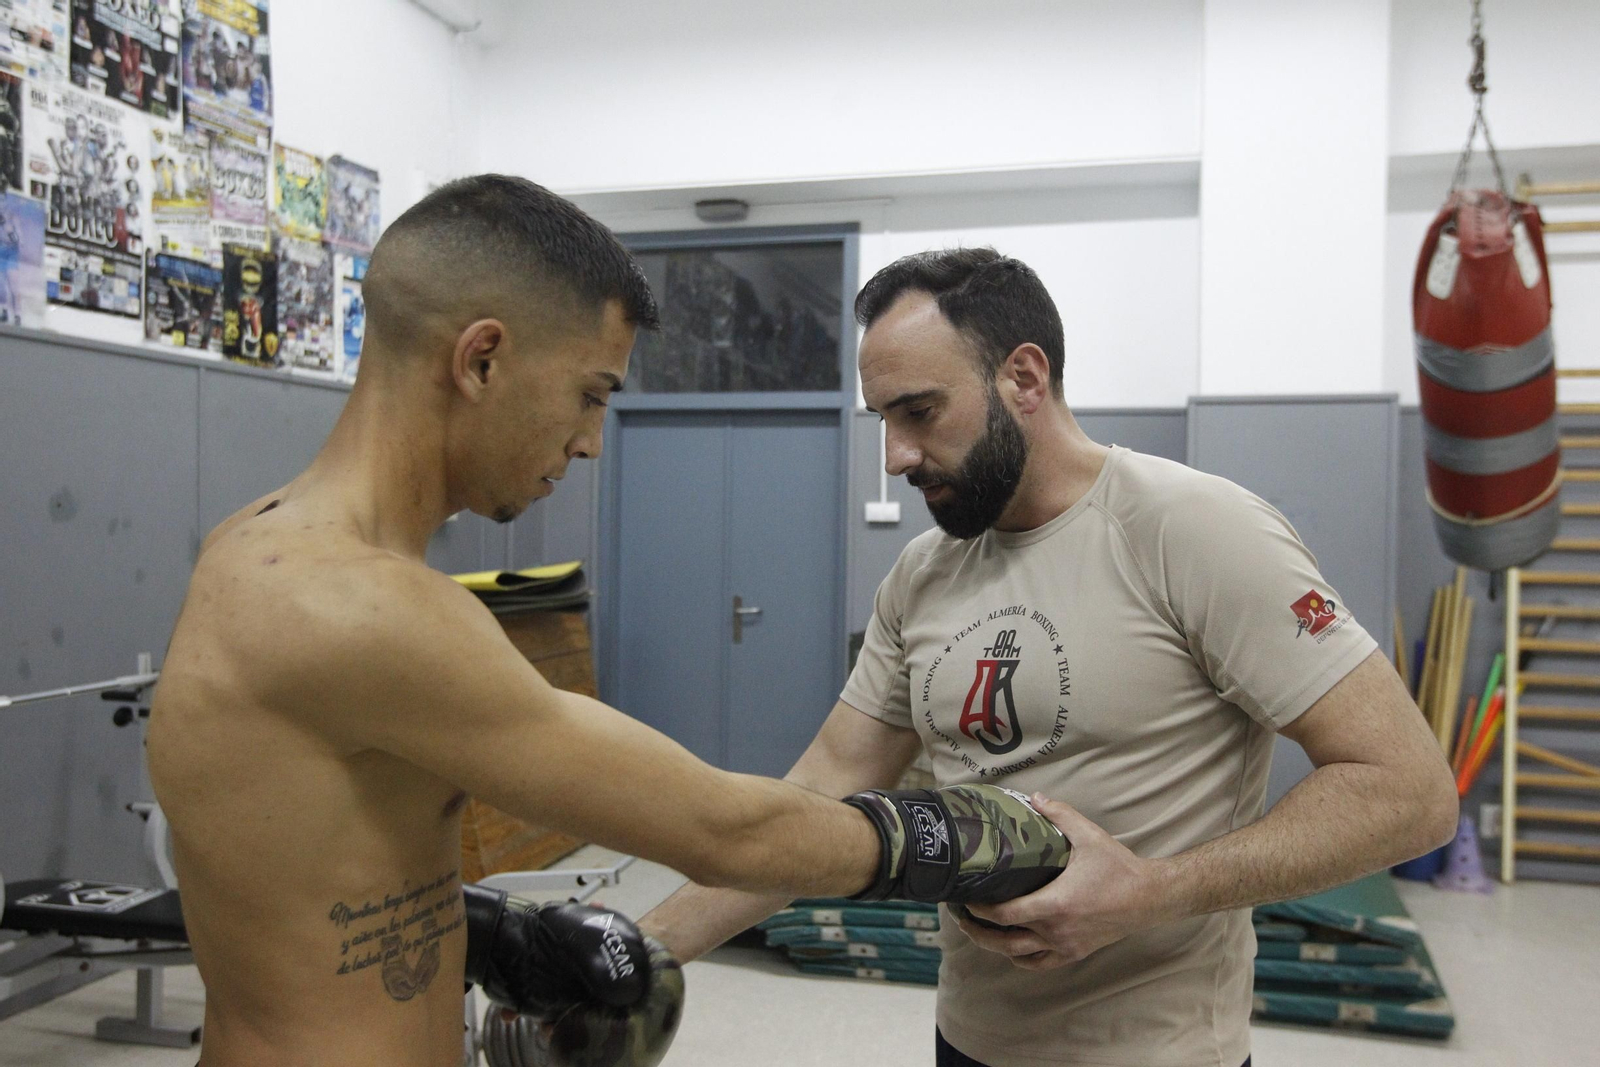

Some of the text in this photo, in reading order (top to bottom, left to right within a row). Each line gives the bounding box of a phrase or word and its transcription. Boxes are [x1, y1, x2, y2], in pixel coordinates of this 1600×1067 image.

[953, 604, 1060, 643] TEAM ALMERÍA BOXING
[922, 656, 942, 702] BOXING
[1057, 657, 1071, 697] TEAM
[1037, 704, 1069, 756] ALMERÍA
[960, 753, 980, 773] TEAM
[991, 756, 1037, 777] BOXING
